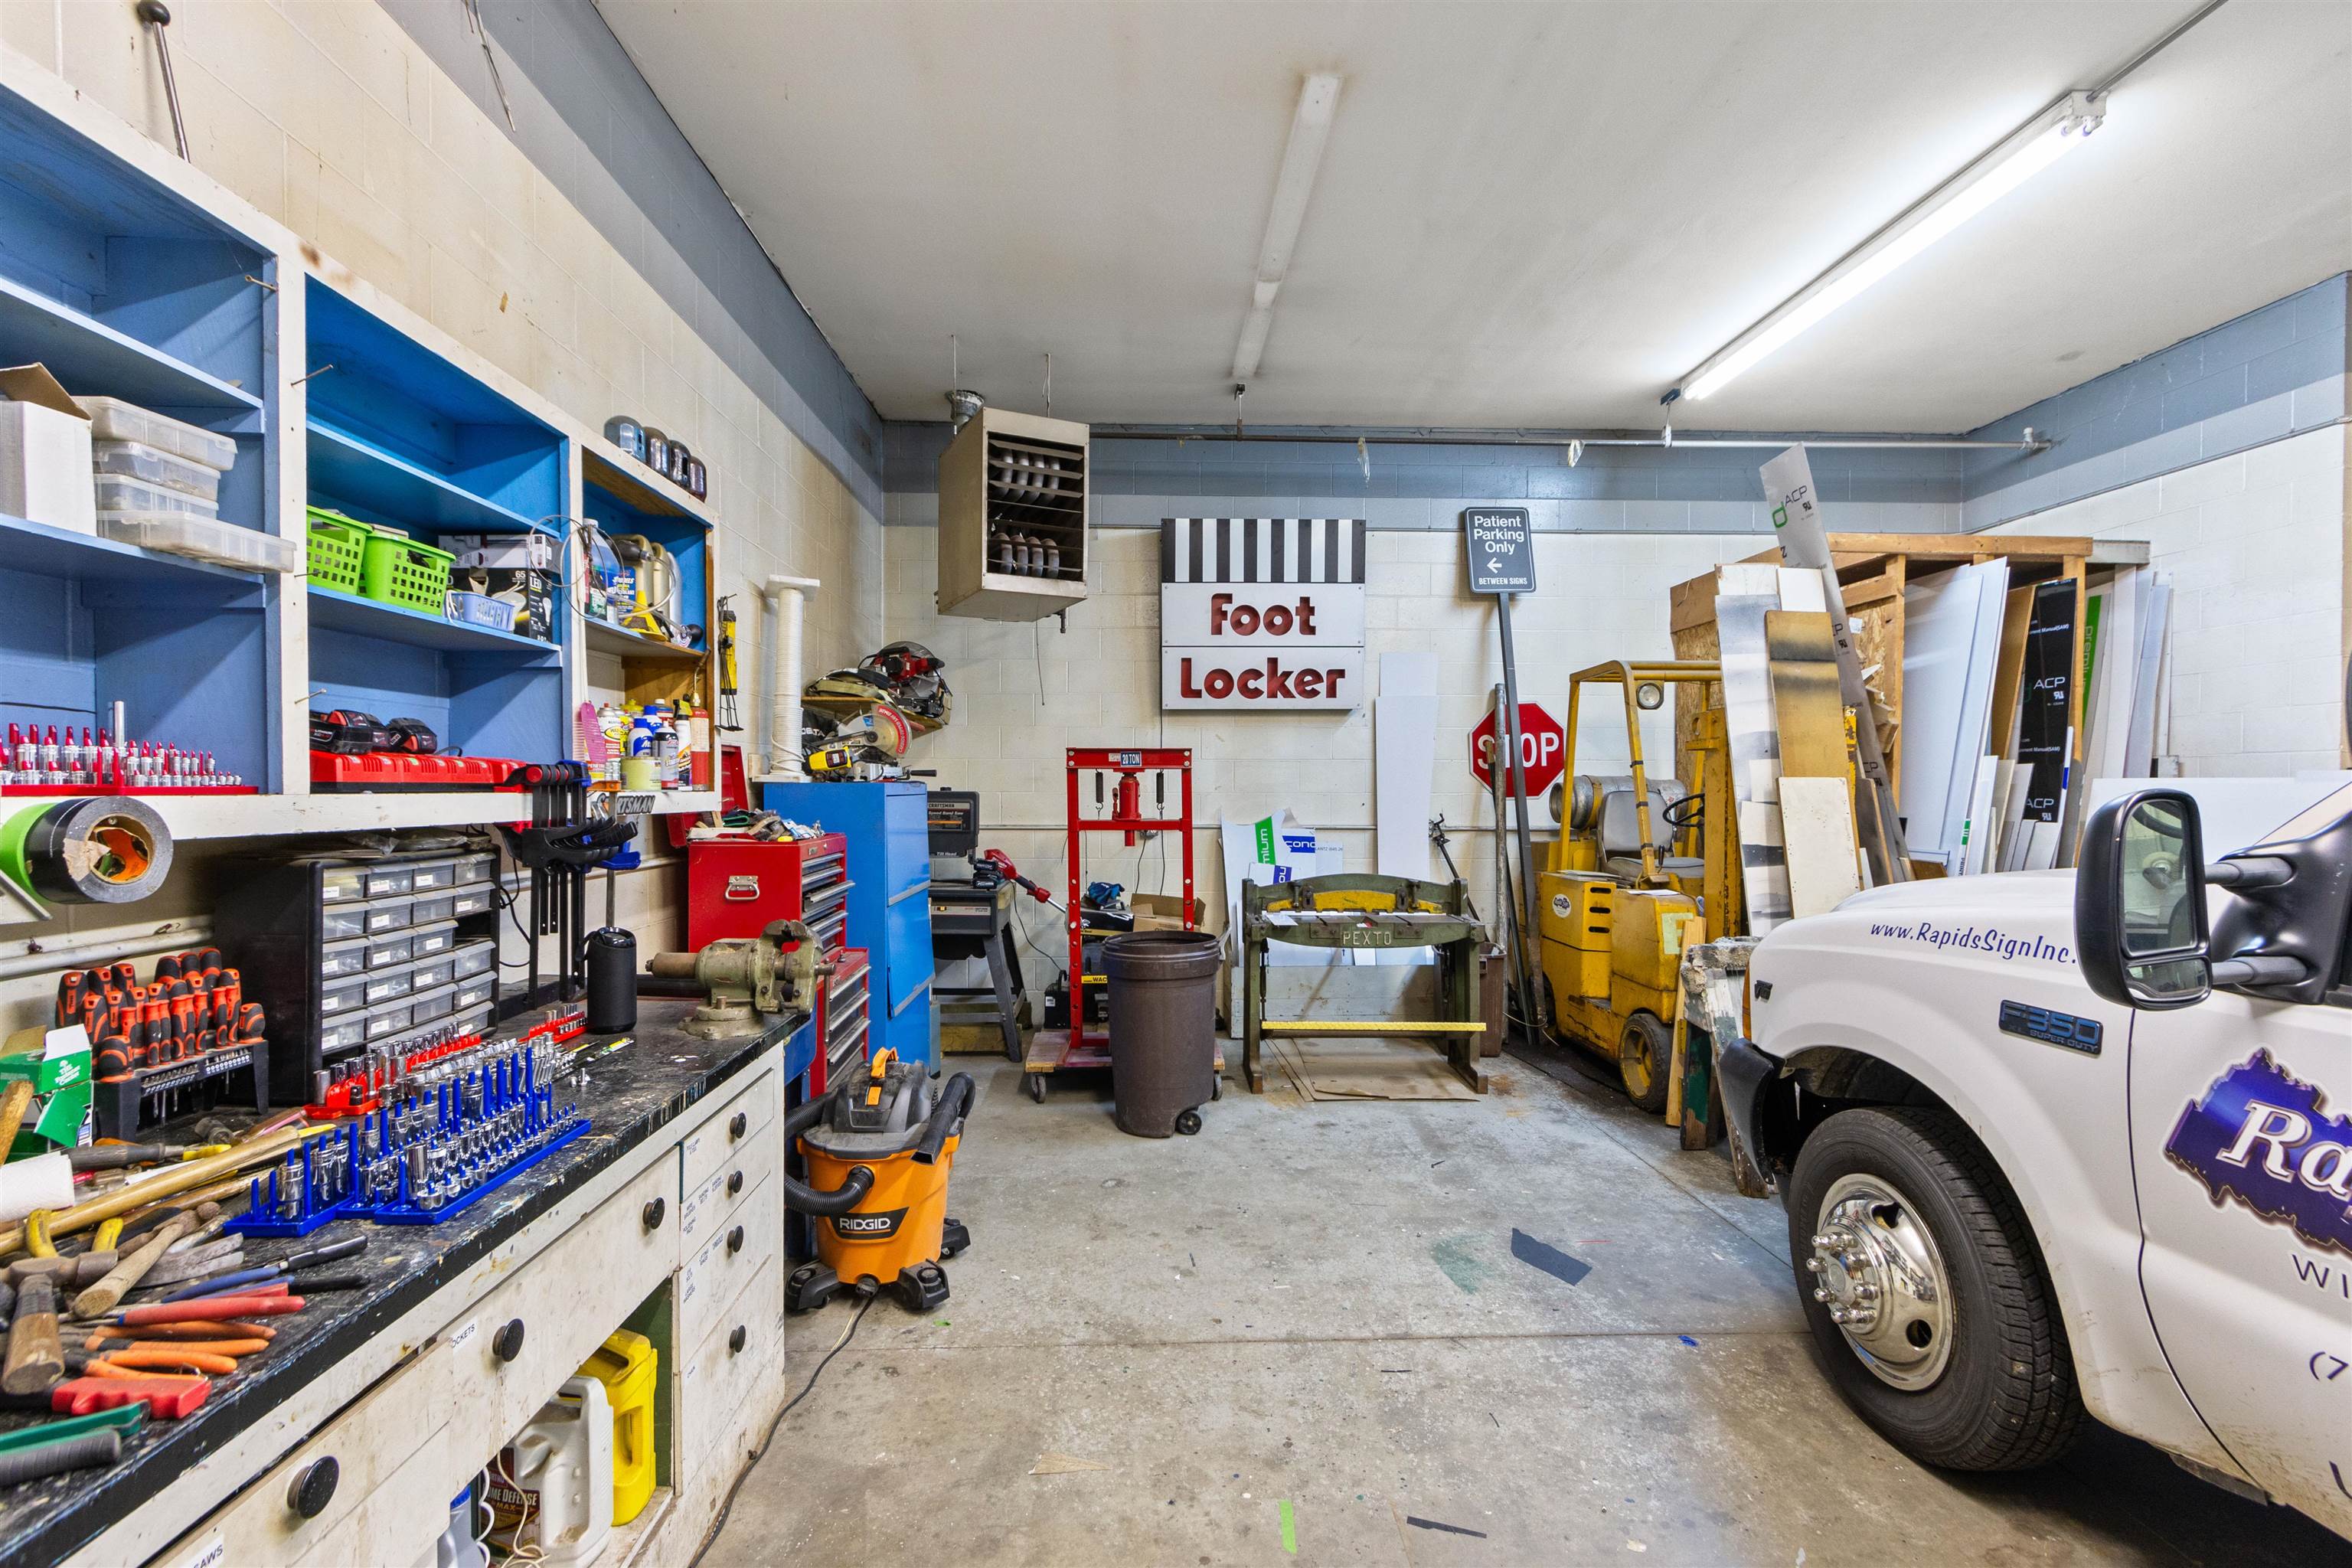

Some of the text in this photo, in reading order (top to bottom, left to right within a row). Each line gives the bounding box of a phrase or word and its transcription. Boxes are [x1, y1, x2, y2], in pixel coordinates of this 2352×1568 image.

[1474, 515, 1522, 527] Patient
[1474, 528, 1524, 542] Parking
[1485, 541, 1515, 555] Only
[1210, 593, 1316, 635] Foot
[1181, 657, 1346, 699] Locker
[2034, 677, 2066, 689] ACP
[1122, 753, 1129, 764] 20
[1129, 753, 1139, 764] TON
[1343, 930, 1391, 945] PEXTO
[2030, 1029, 2065, 1044] SUPER
[2068, 1038, 2099, 1053] DUTY
[2216, 1099, 2352, 1223] Ra
[839, 1217, 890, 1230] RIDGID
